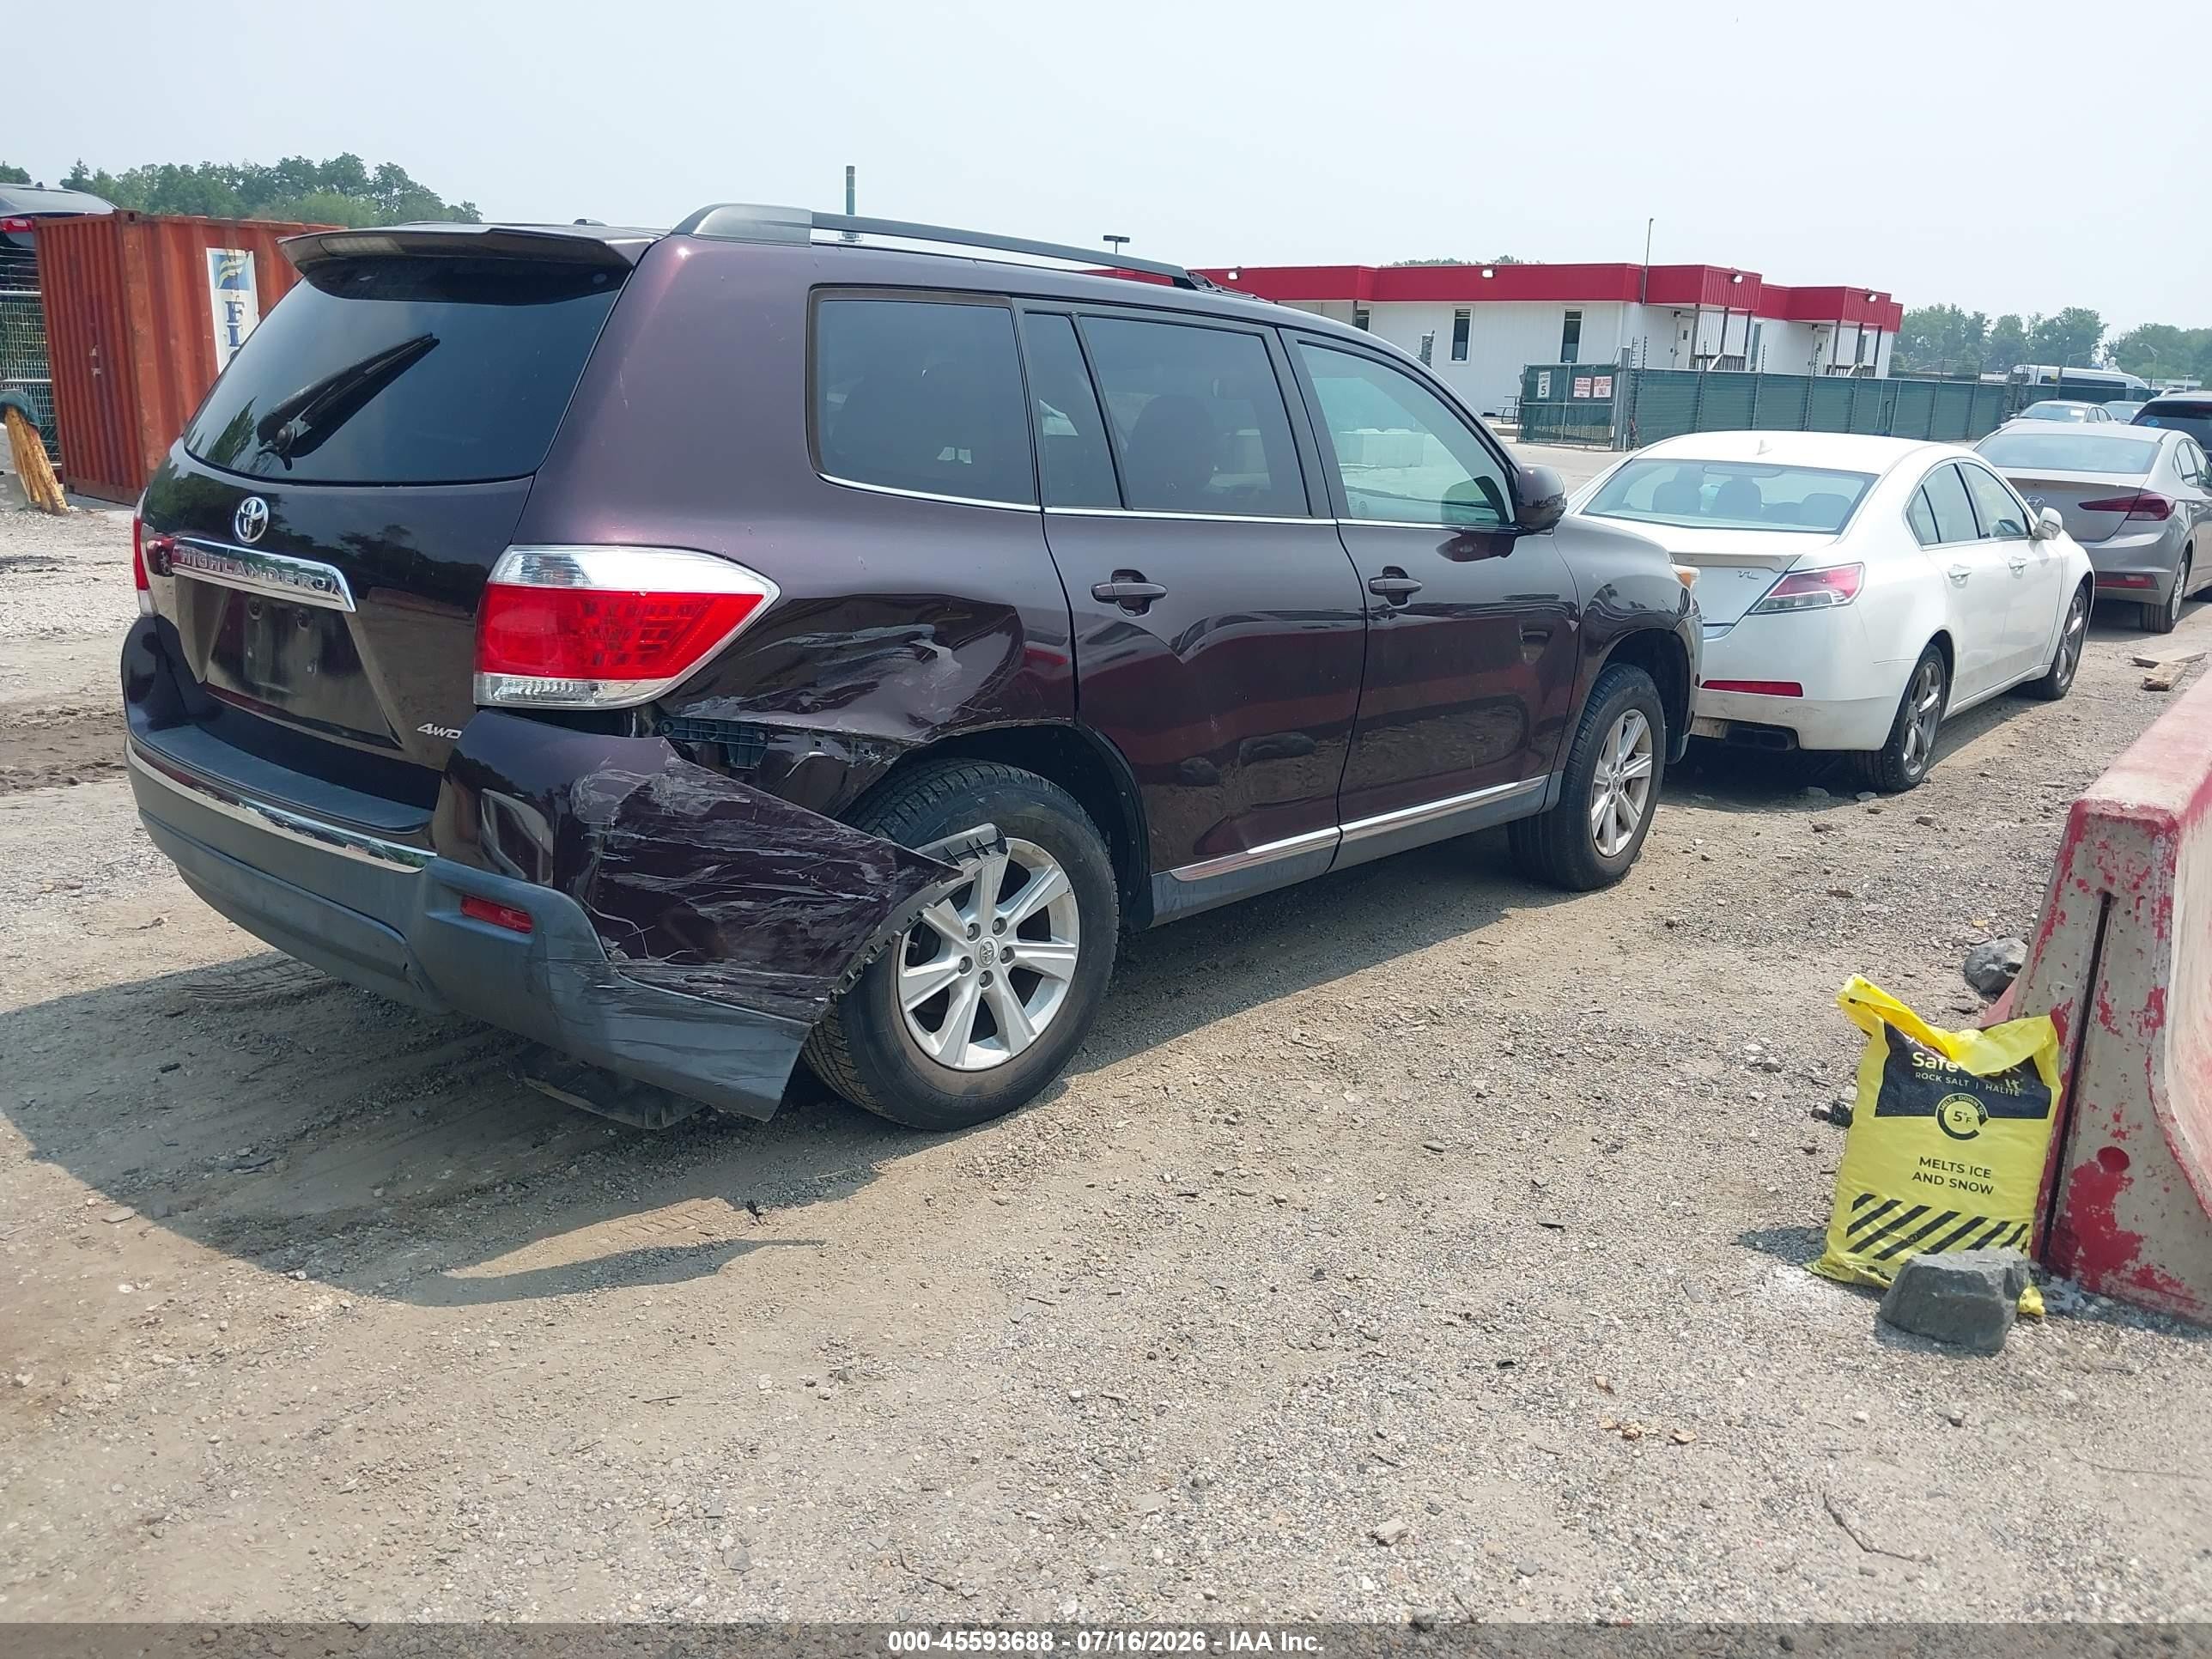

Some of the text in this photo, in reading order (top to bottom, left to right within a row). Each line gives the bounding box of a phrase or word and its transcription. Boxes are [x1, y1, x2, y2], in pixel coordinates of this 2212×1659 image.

[1541, 385, 1547, 395] 5
[180, 547, 317, 592] HIGHLANDER
[416, 723, 463, 739] 4WD
[1915, 1072, 2021, 1097] ROCK SALT HALITE
[1939, 1095, 1985, 1115] MELTS DOWN TO
[1919, 1156, 1991, 1179] MELTS ICE
[1911, 1171, 1994, 1194] AND SNOW
